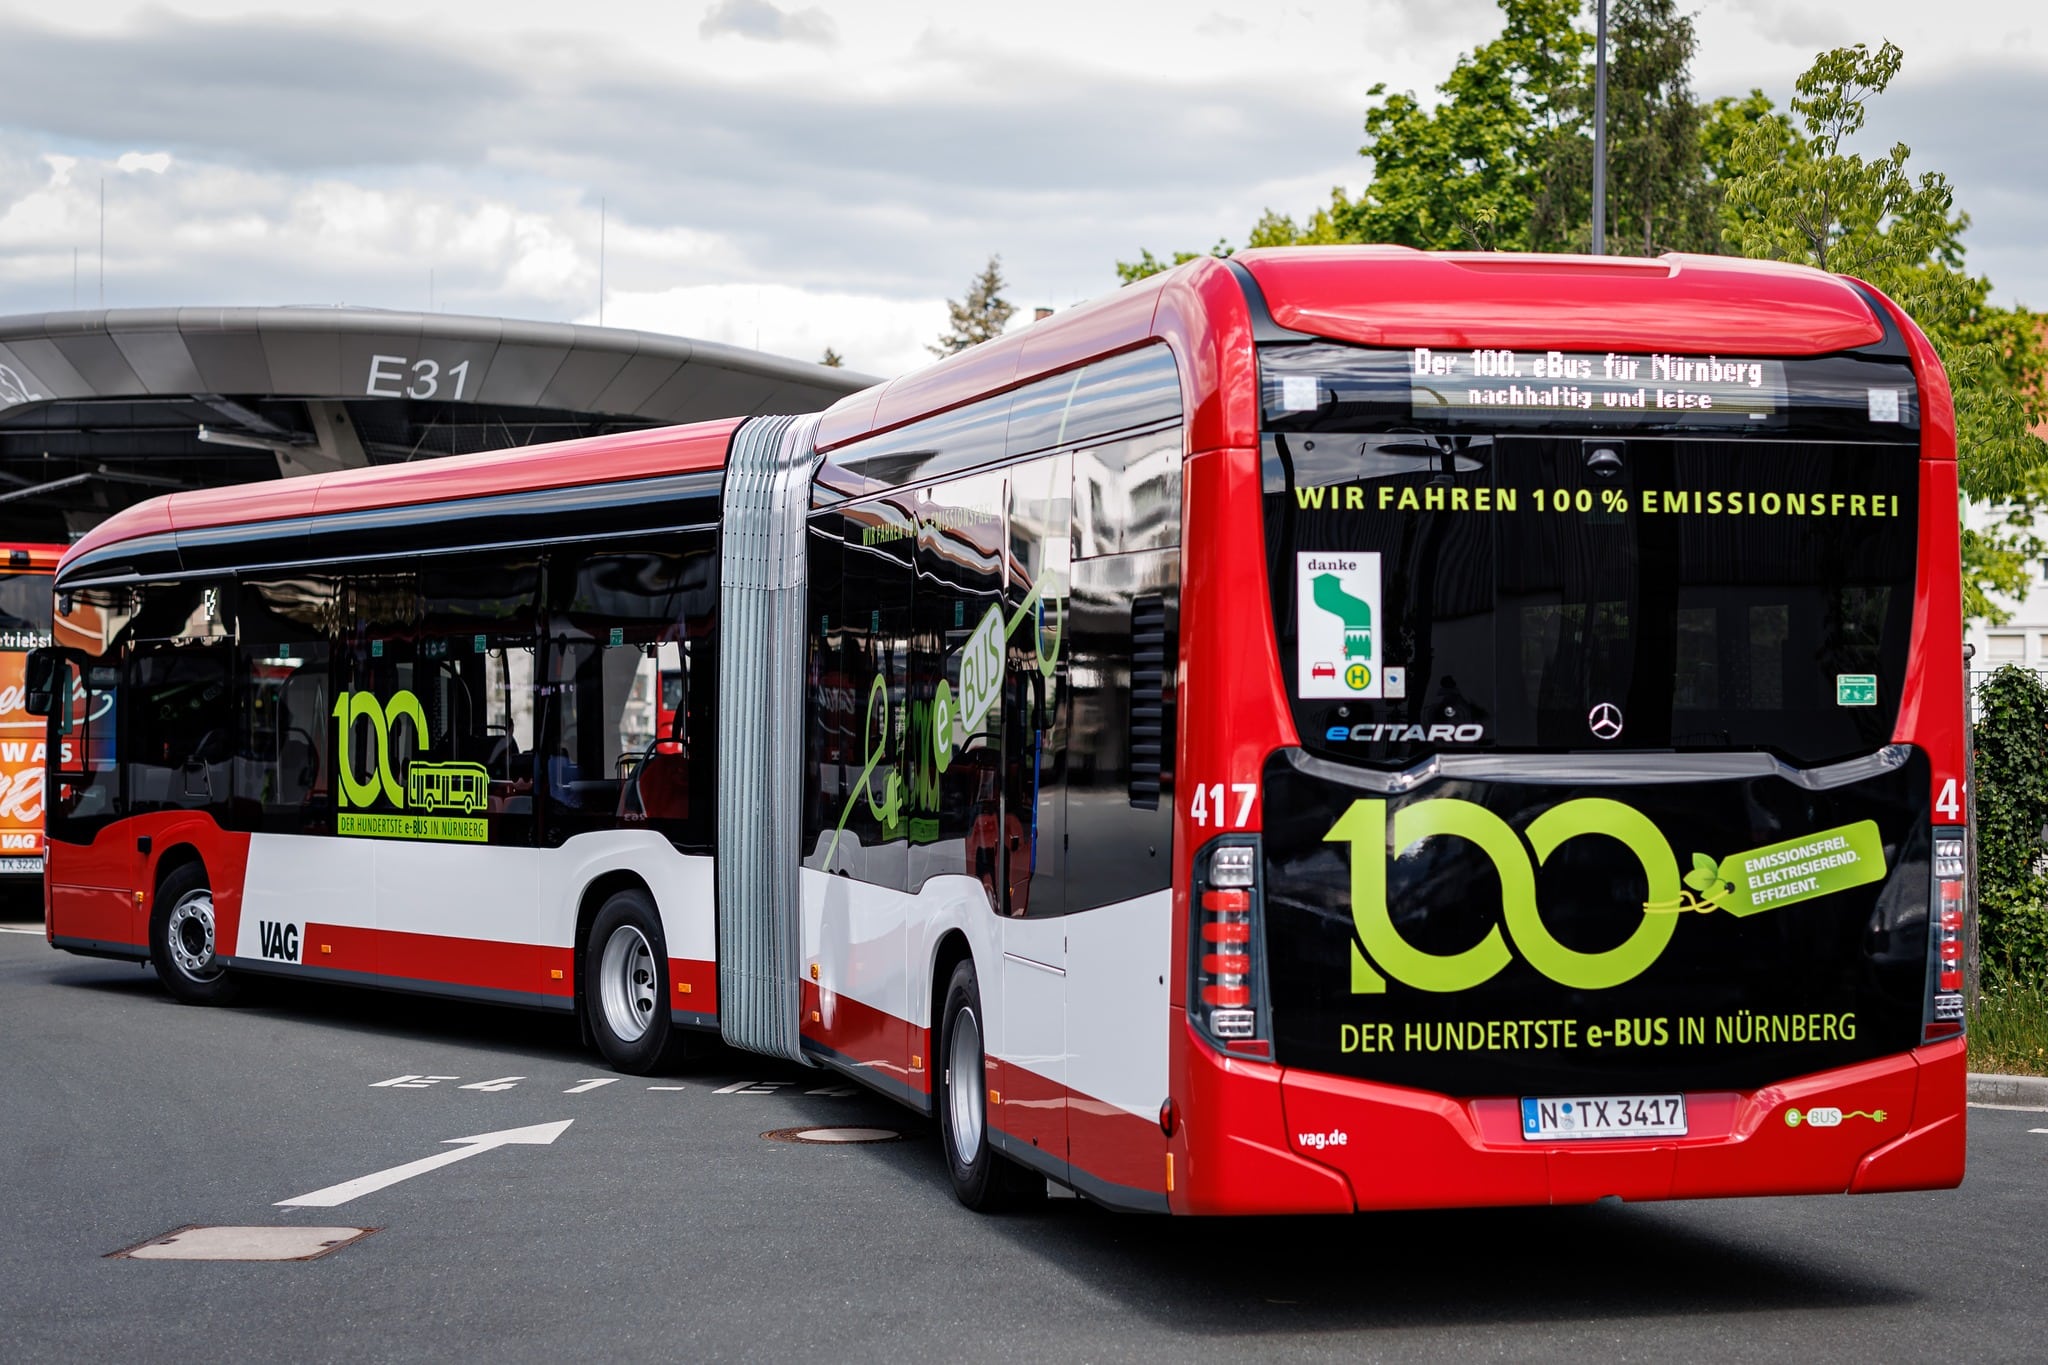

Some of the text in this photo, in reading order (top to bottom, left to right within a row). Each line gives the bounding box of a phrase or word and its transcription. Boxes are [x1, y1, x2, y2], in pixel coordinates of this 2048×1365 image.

[366, 354, 469, 400] E31
[1414, 348, 1762, 388] Der 100. eBus für Nürnberg
[1468, 385, 1712, 409] nachhaltig und leise
[1295, 486, 1900, 518] WIR FAHREN 100 % EMISSIONSFREI
[1308, 558, 1357, 571] danke
[937, 617, 1000, 753] e BUS
[1326, 723, 1484, 742] eCITARO
[332, 689, 430, 810] 100
[1190, 782, 1257, 827] 417
[2, 833, 37, 849] VAG
[341, 816, 484, 837] DER HUNDERTSTE e-BUS IN NÜRNBERG
[16, 859, 41, 871] 3220
[1744, 836, 1850, 873] EMISSIONSFREI.
[1748, 850, 1861, 889] ELEKTRISIEREND.
[1322, 797, 1681, 994] 100
[1751, 877, 1820, 905] EFFIZIENT.
[259, 920, 299, 961] VAG
[1341, 1010, 1856, 1052] DER HUNDERTSTE e-BUS IN NÜRNBERG
[1540, 1102, 1558, 1129] N
[1576, 1101, 1611, 1128] TX
[1617, 1098, 1680, 1126] 3417
[1810, 1110, 1838, 1124] BUS
[1298, 1129, 1348, 1149] vag.de
